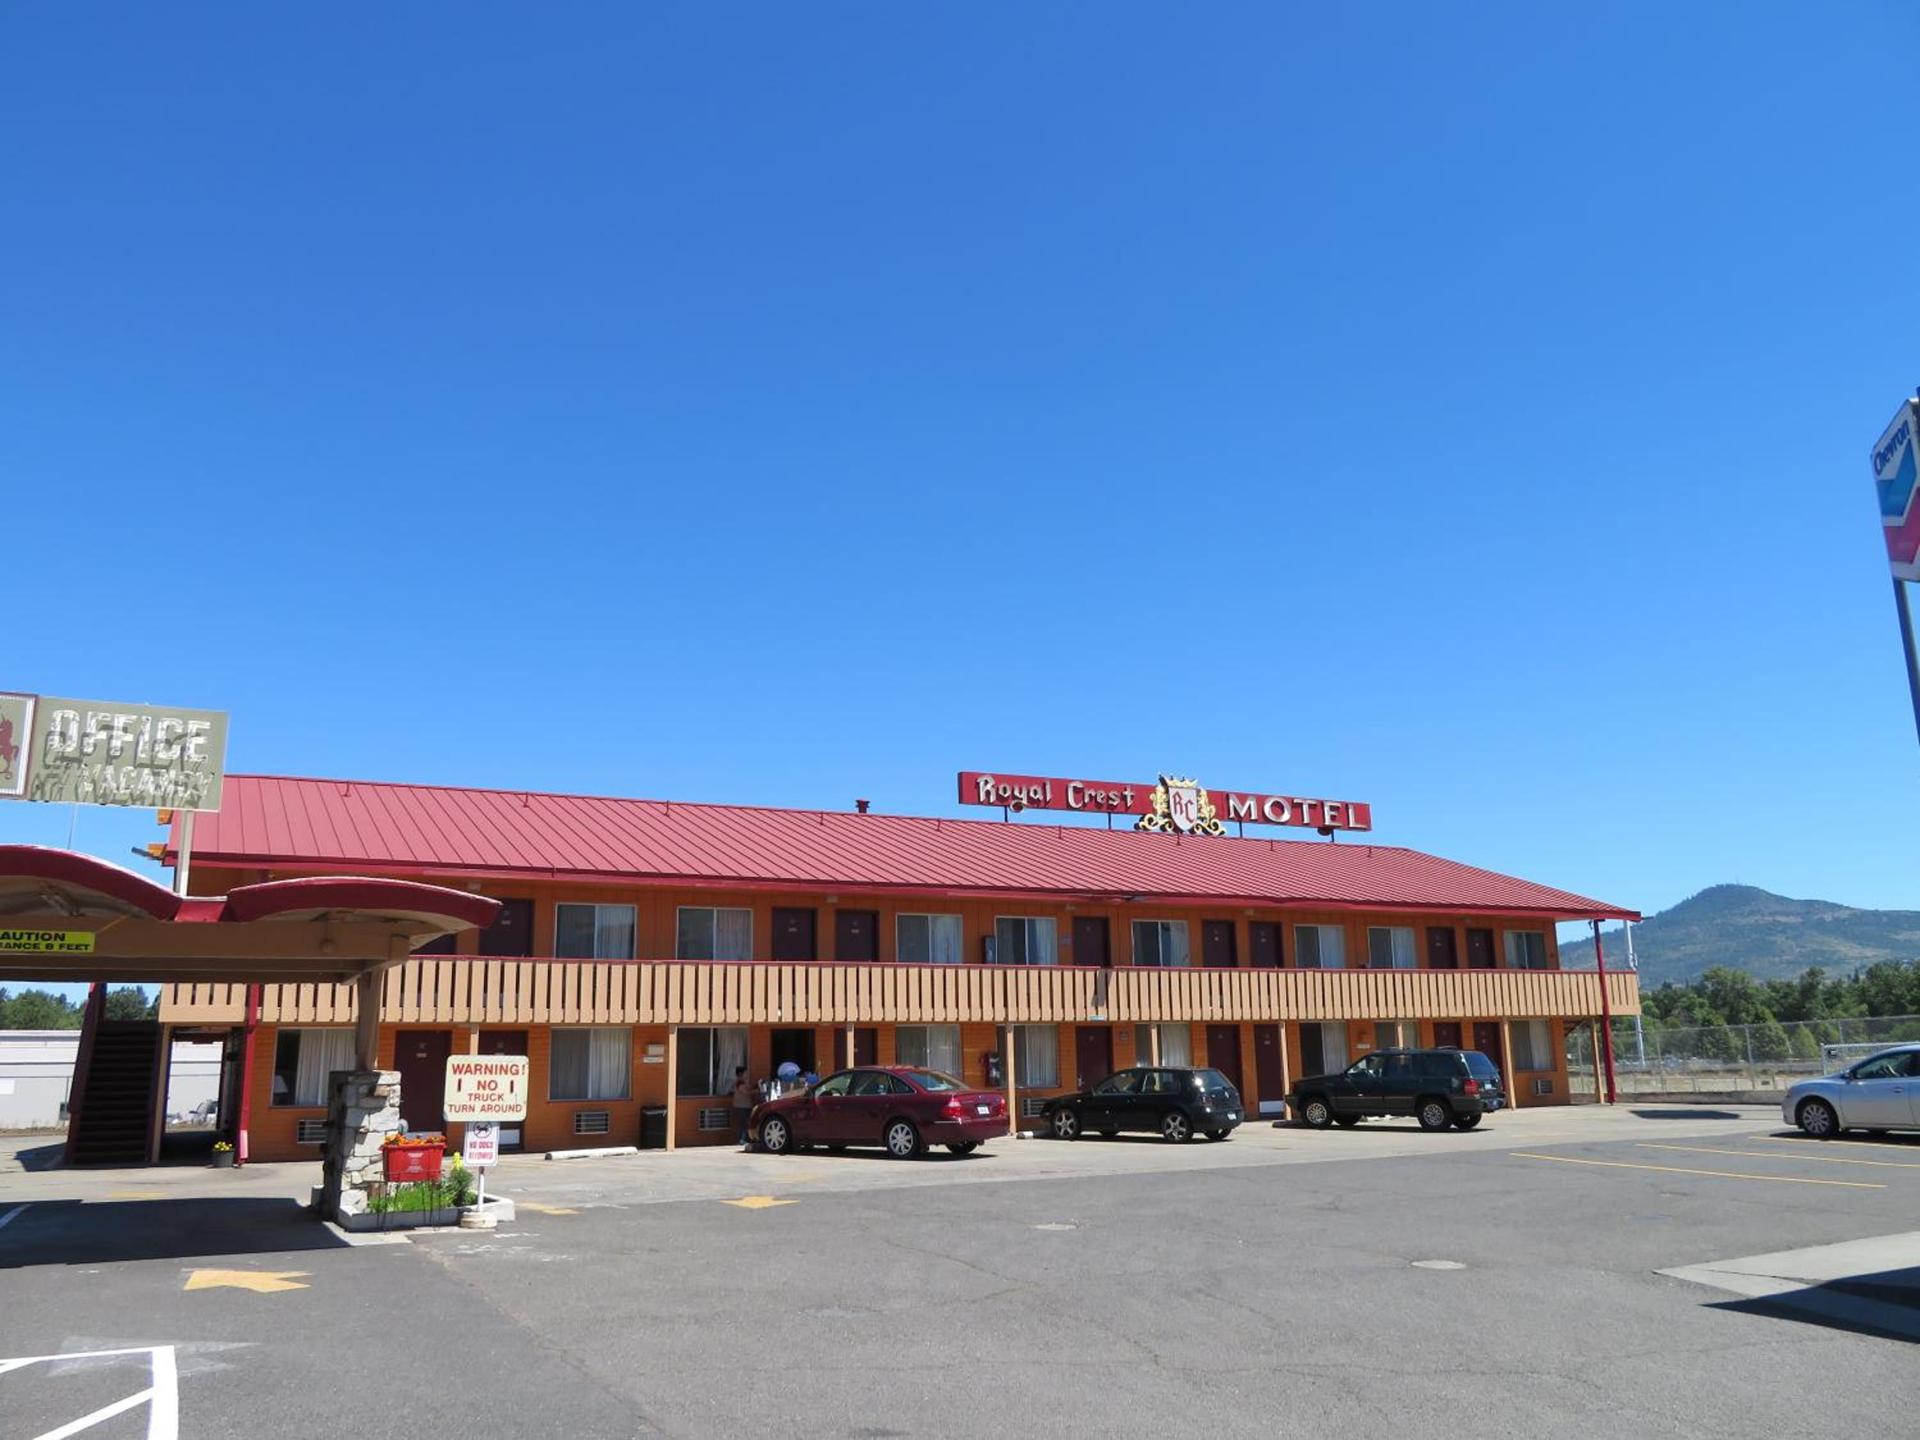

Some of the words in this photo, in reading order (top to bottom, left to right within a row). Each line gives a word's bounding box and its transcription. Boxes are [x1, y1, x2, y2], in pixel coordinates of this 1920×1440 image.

[1874, 420, 1910, 476] Chevron
[50, 709, 211, 762] OFFICE
[976, 775, 1052, 813] Royal
[1067, 780, 1135, 810] Crest
[1172, 791, 1195, 823] RC
[1228, 793, 1369, 829] MOTEL
[59, 943, 90, 951] FEET
[452, 1063, 526, 1076] WARNING!
[477, 1080, 498, 1091] NO
[449, 1103, 475, 1113] TURN
[480, 1104, 522, 1113] AROUND
[468, 1093, 504, 1102] TRUCK
